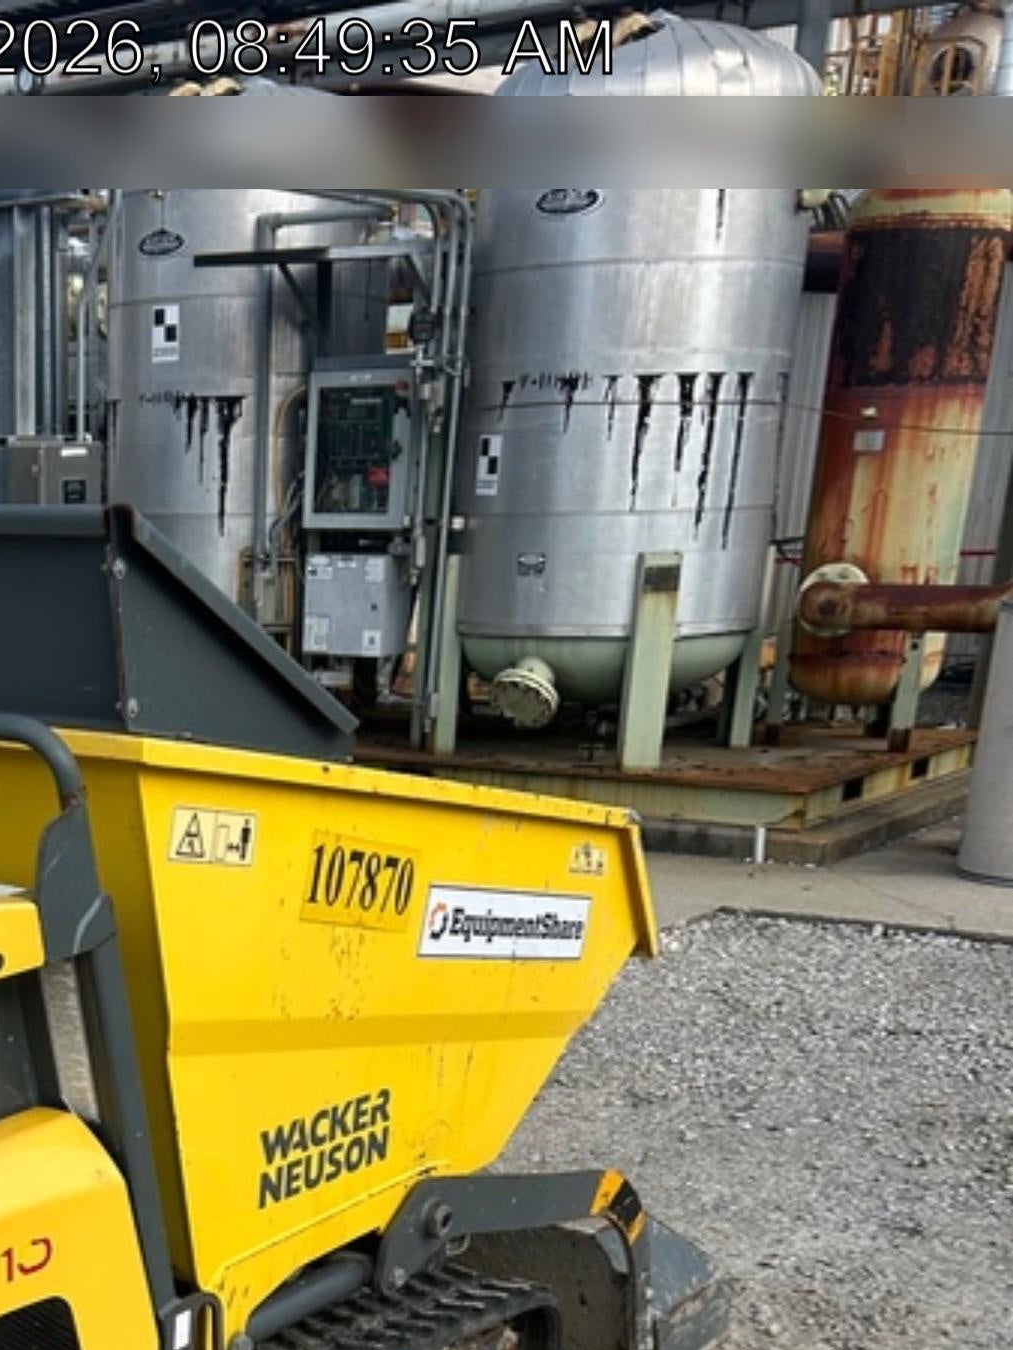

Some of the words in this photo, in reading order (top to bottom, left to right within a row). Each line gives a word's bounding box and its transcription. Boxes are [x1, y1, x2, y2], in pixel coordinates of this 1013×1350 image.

[306, 843, 415, 916] 107870
[449, 906, 584, 943] EquipmentShare
[259, 1088, 391, 1165] WACKER
[258, 1126, 391, 1210] NEUSON
